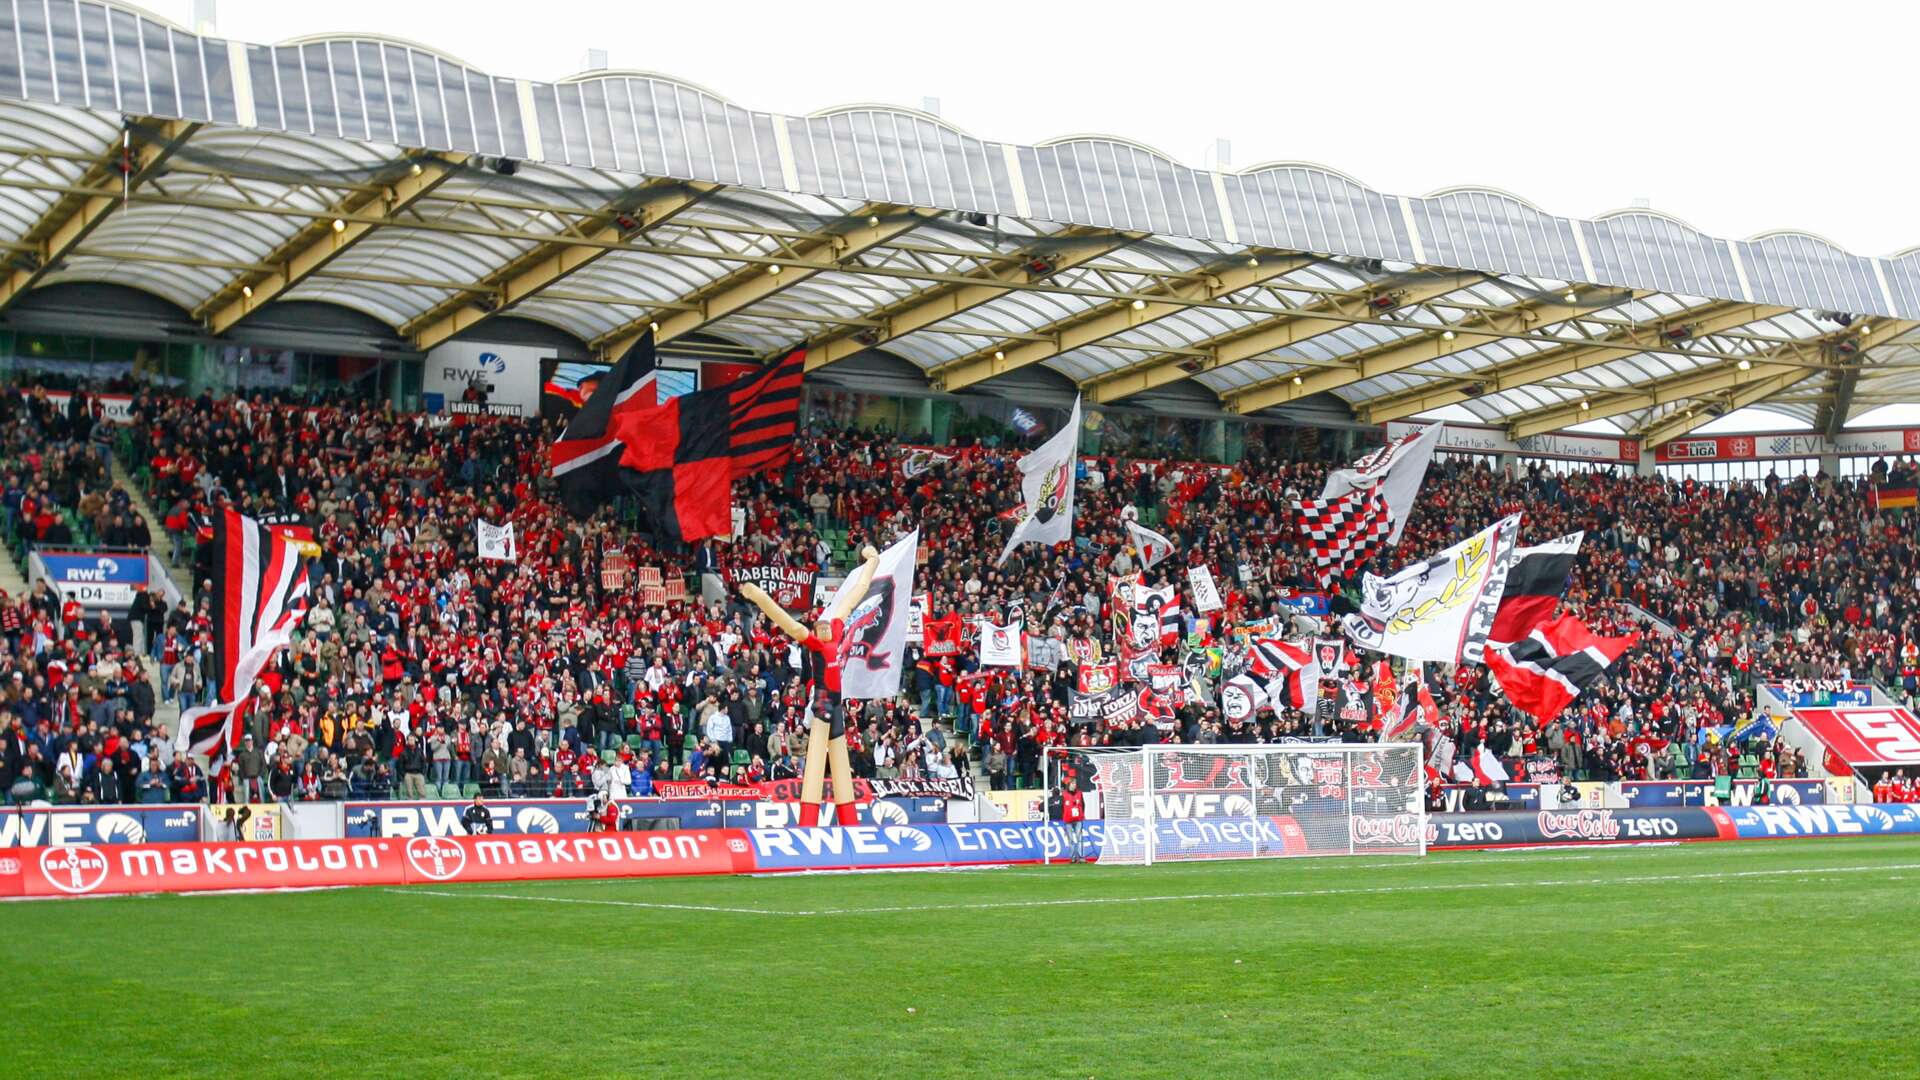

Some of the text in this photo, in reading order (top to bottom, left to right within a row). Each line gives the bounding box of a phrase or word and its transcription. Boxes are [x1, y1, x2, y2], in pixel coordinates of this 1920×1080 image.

[443, 367, 488, 382] RWE
[451, 402, 480, 414] BAYER
[488, 405, 521, 416] POWER
[1534, 434, 1560, 453] EVL
[1689, 447, 1716, 456] LIGA
[1793, 436, 1829, 453] EVL
[66, 568, 106, 581] RWE
[729, 566, 814, 584] HABERLANDS
[81, 587, 103, 599] D4
[1103, 690, 1137, 715] FORZA
[872, 777, 974, 800] BLACK ANGELS
[165, 818, 189, 827] RWE
[1538, 810, 1678, 838] Coca-Cola zero
[1753, 805, 1863, 834] RWE
[0, 813, 91, 848] WE
[1352, 814, 1503, 843] Coca-Cola zero
[750, 826, 889, 857] RWE
[412, 848, 461, 859] BAYER
[46, 858, 103, 870] BAYER
